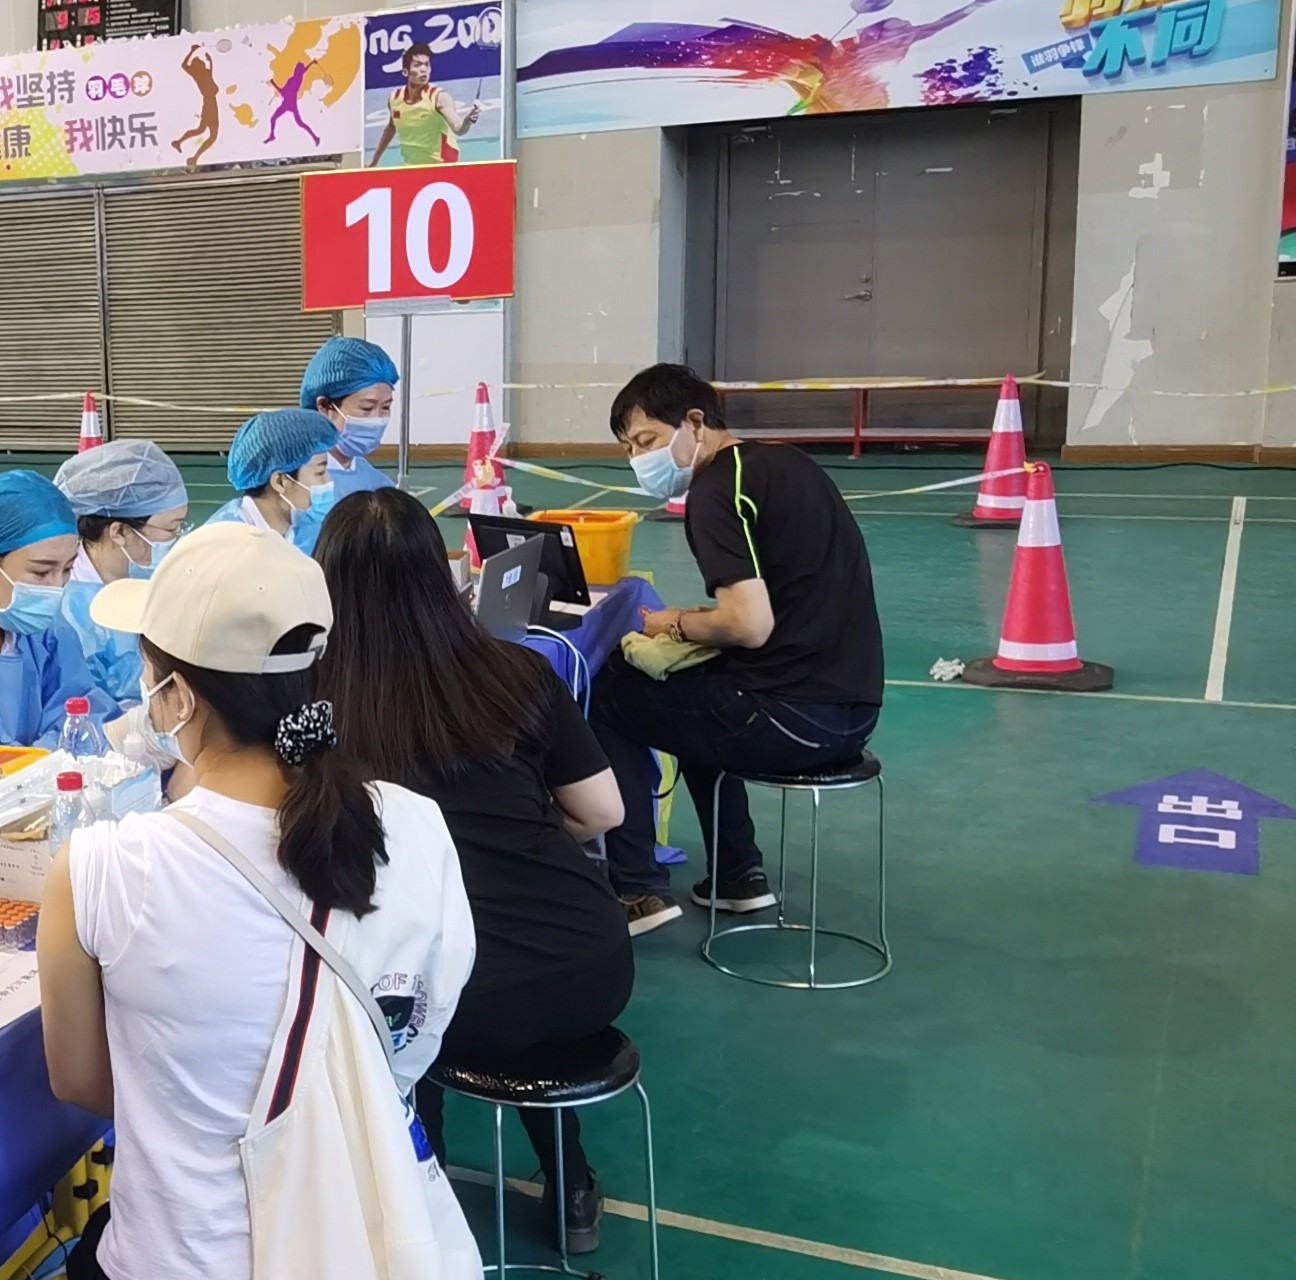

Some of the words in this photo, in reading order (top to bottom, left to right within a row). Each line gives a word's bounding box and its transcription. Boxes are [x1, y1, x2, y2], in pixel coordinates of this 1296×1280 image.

[86, 71, 152, 100] 羽毛球
[64, 112, 158, 153] 我快乐
[345, 181, 475, 293] 10
[1157, 794, 1243, 850] 出口
